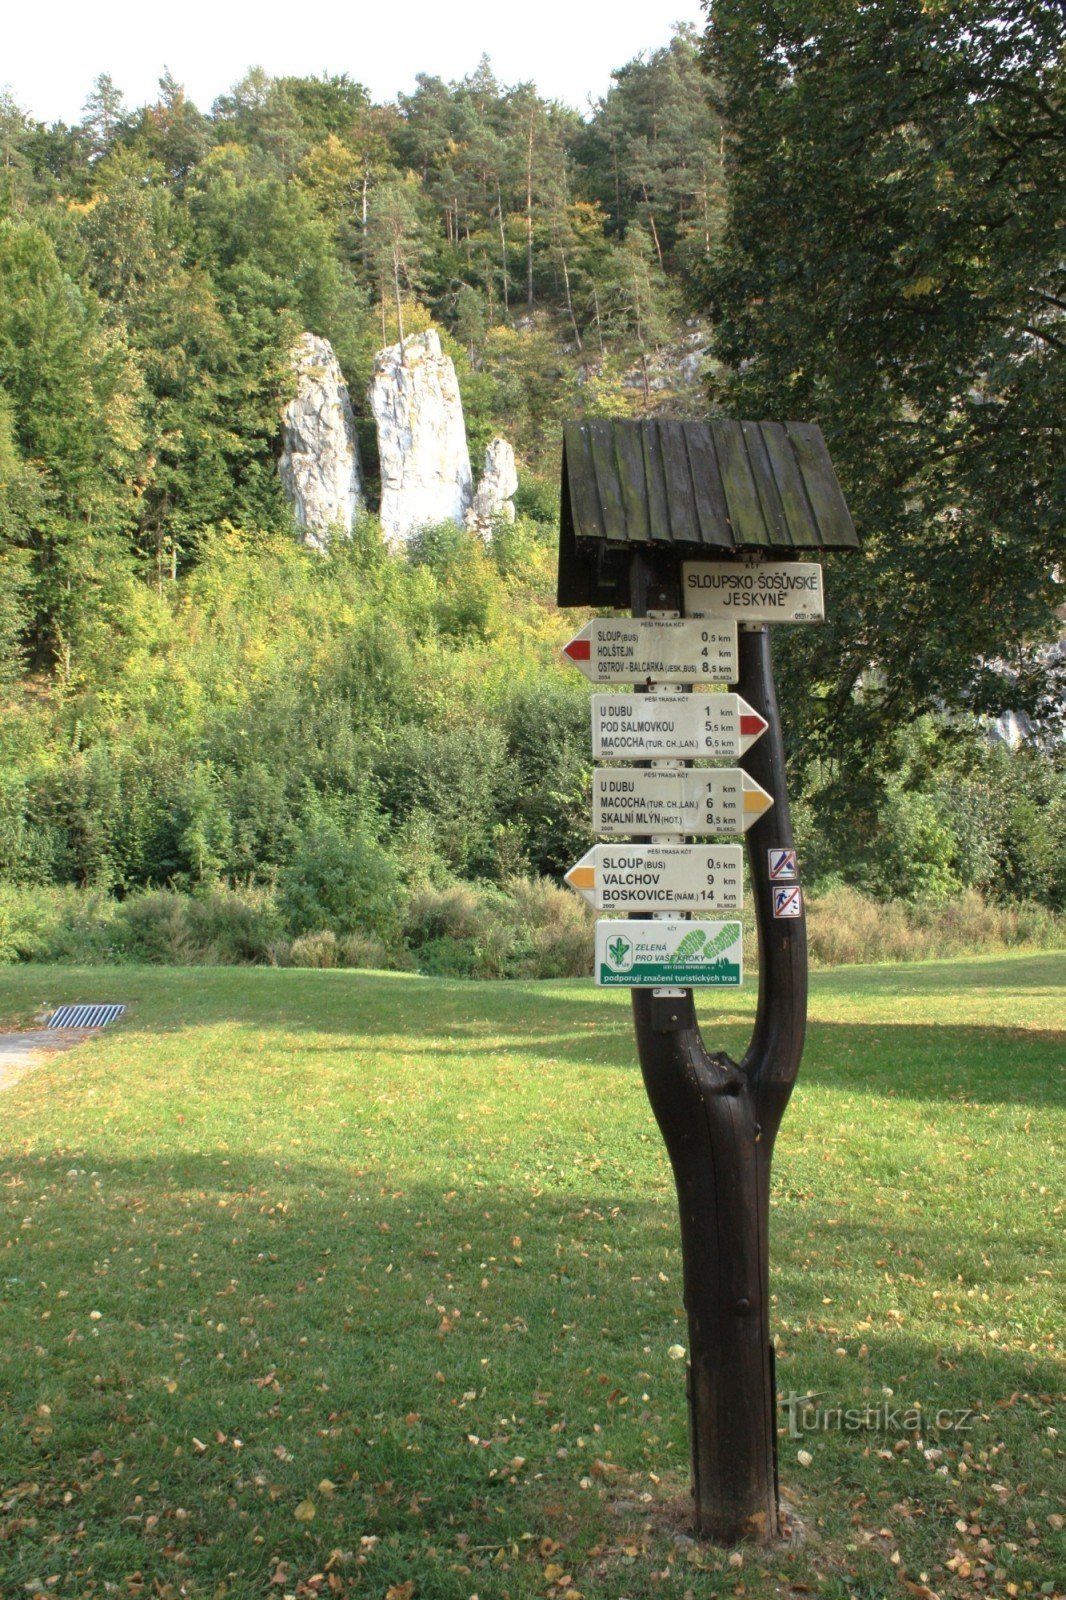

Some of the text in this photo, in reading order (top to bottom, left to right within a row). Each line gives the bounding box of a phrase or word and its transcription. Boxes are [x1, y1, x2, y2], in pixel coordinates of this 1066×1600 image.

[723, 591, 786, 606] JESKYNĚ
[598, 632, 621, 641] SLOUP
[701, 632, 715, 643] 0,5
[598, 644, 633, 656] HOLŠTEJN
[701, 647, 708, 656] 4
[598, 662, 624, 672] OSTROV
[630, 662, 663, 672] BALCARKA
[702, 663, 717, 673] 8,5
[601, 707, 606, 716] U
[609, 707, 632, 716] DUBU
[705, 707, 710, 716] 1
[601, 722, 618, 732] POD
[621, 722, 674, 732] SALMOVKOU
[705, 722, 718, 732] 5,5
[601, 738, 644, 747] MACOCHA
[705, 737, 719, 747] 6,5
[601, 782, 606, 792] U
[609, 782, 634, 792] DUBU
[706, 783, 711, 792] 1
[601, 798, 645, 807] MACOCHA
[706, 798, 713, 808] 6
[602, 811, 633, 823] SKALNÍ
[636, 811, 660, 823] MLÝN
[706, 814, 720, 825] 8,5
[603, 858, 643, 868] SLOUP
[707, 859, 720, 870] 0,5
[603, 874, 660, 884] VALCHOV
[707, 875, 714, 884] 9
[603, 890, 673, 900] BOSKOVICE
[701, 891, 714, 900] 14
[635, 943, 666, 951] ZELENÁ
[604, 975, 641, 983] podporují
[675, 974, 719, 982] turistických
